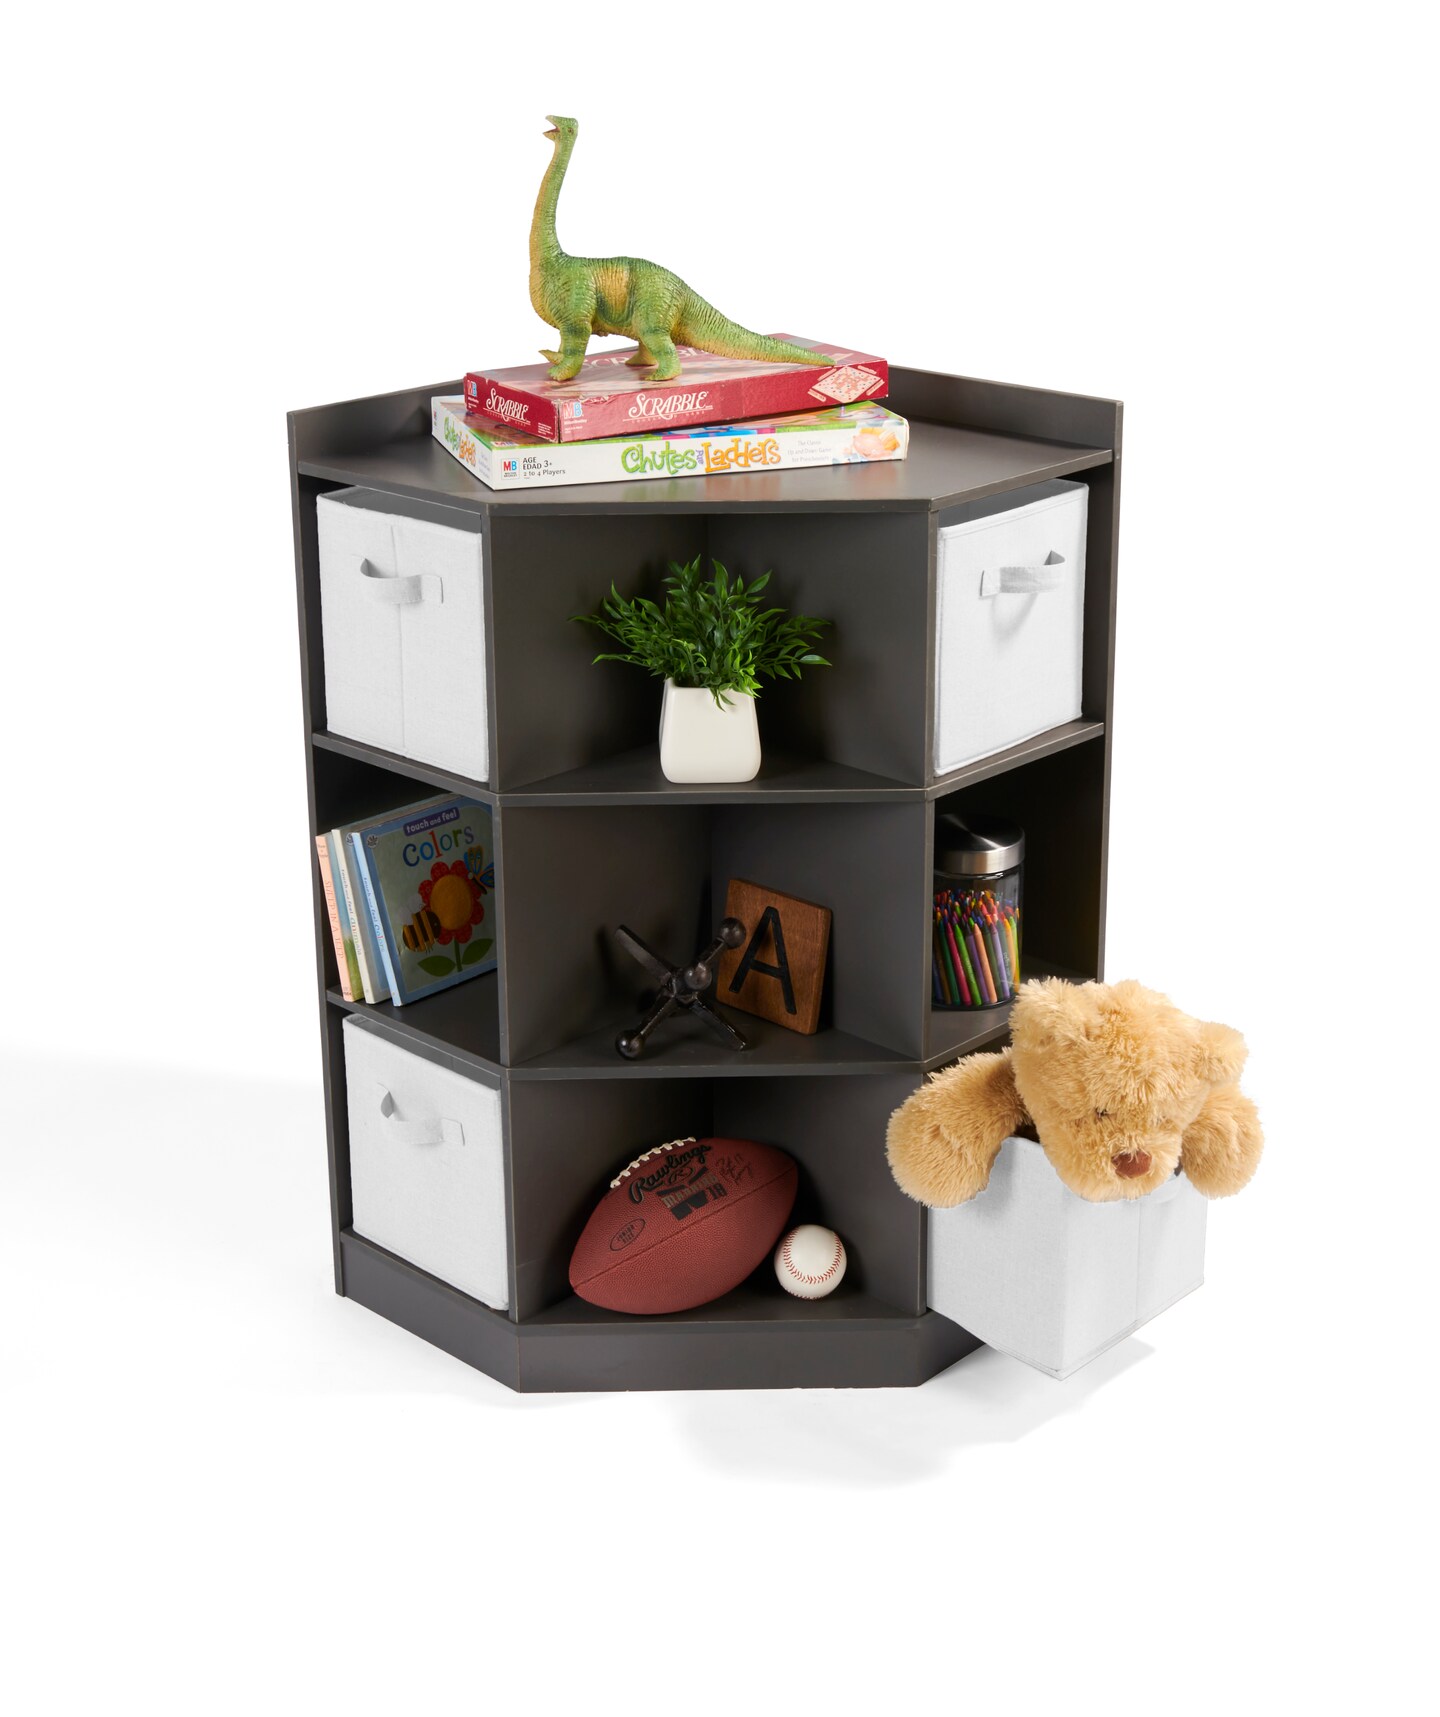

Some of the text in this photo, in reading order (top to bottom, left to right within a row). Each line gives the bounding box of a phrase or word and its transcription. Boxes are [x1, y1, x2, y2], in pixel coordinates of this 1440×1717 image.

[486, 388, 529, 421] SCRABBLE
[563, 402, 583, 419] MB
[628, 391, 708, 420] SCRABBLE
[503, 460, 517, 471] MB
[621, 441, 697, 475] Chutes
[701, 437, 782, 473] Ladders
[542, 469, 566, 477] Players
[406, 808, 457, 833] touch and feel
[403, 826, 474, 867] Colors
[729, 906, 797, 1015] A
[629, 1145, 712, 1204] Rawlings
